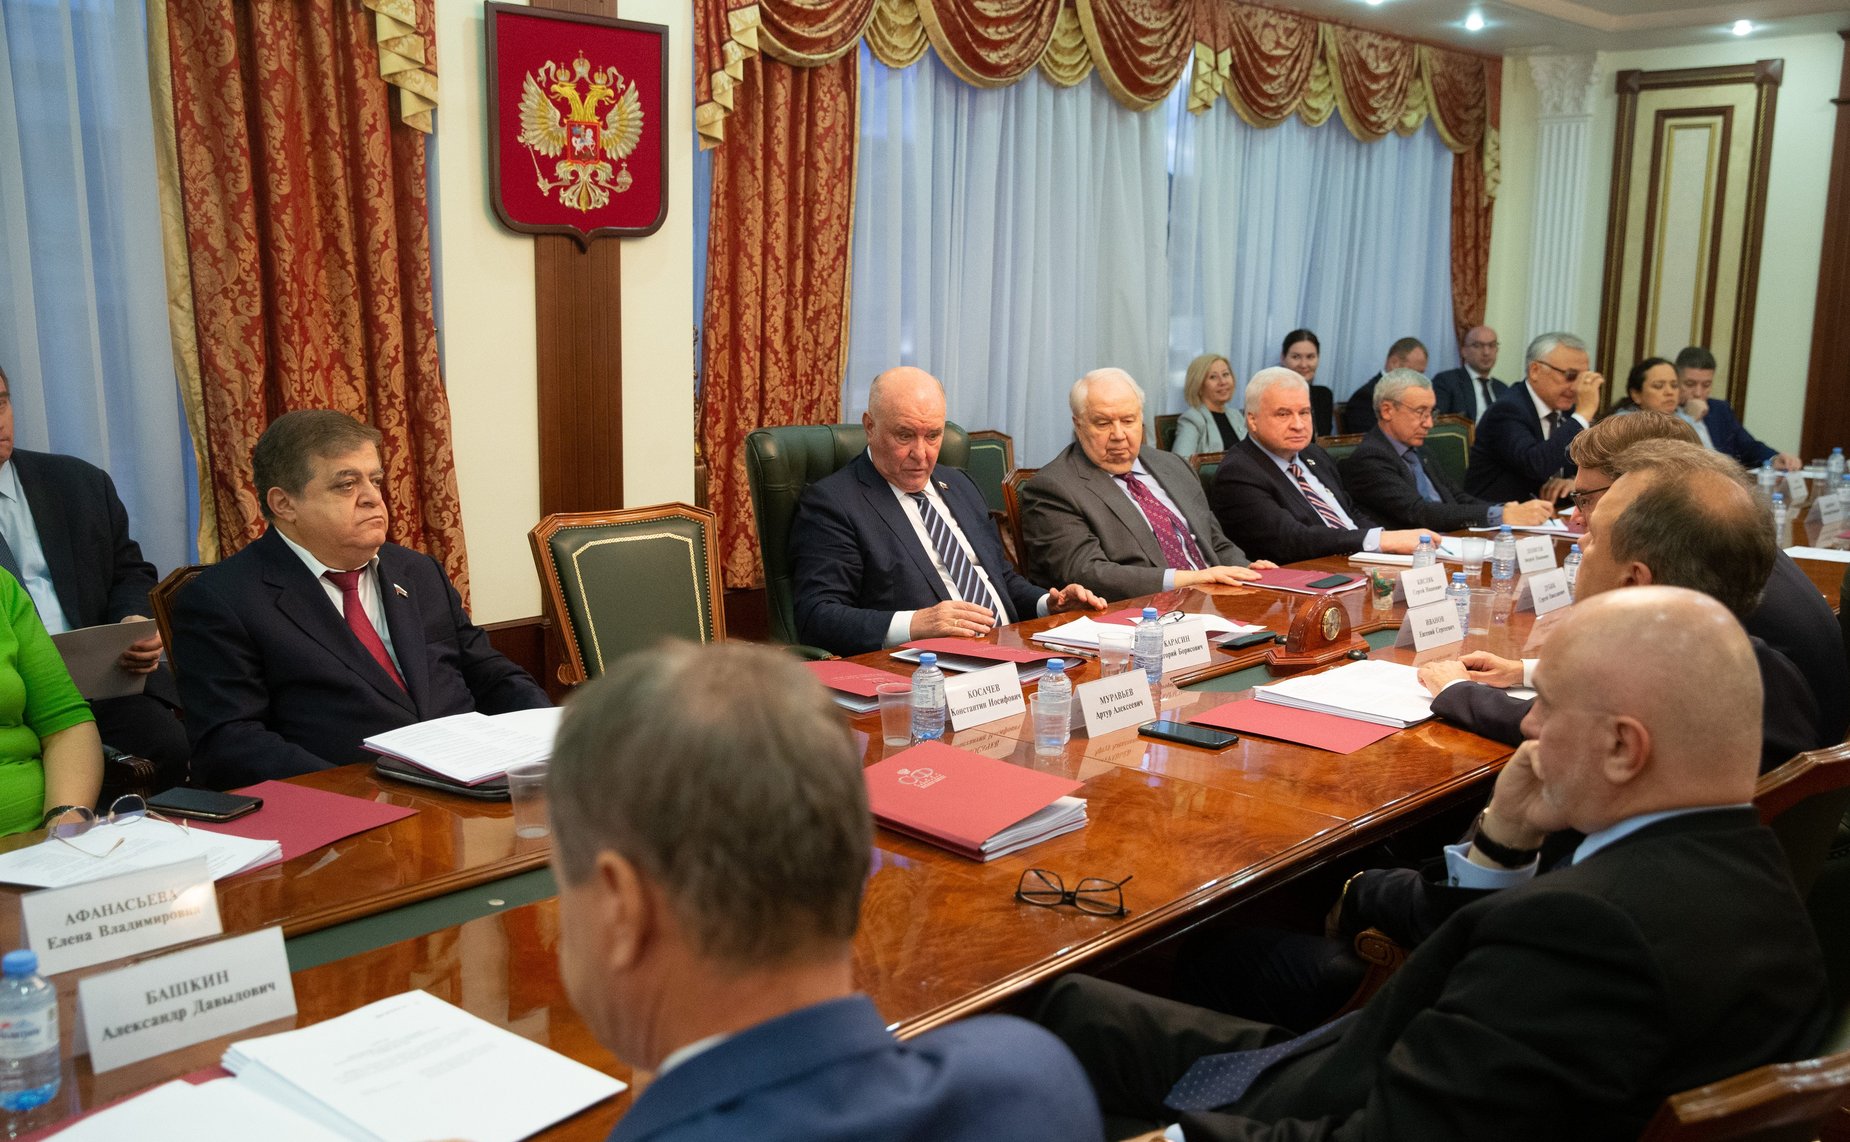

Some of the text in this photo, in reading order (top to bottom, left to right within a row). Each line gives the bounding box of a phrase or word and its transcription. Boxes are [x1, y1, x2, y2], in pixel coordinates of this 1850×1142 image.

[1163, 634, 1191, 648] КАРАСИН
[1162, 645, 1203, 660] горий Борисович
[967, 684, 1001, 699] КОСАЧЕВ
[1099, 688, 1134, 705] МУРАВЬЕВ
[950, 693, 1022, 717] Константин Иосифович
[1096, 700, 1144, 720] Артур Алексеевич
[65, 889, 178, 926] АФАНАСЬЕВА
[47, 930, 93, 951] Елена
[145, 969, 230, 1005] БАШКИН
[102, 981, 277, 1042] Александр Давыдович
